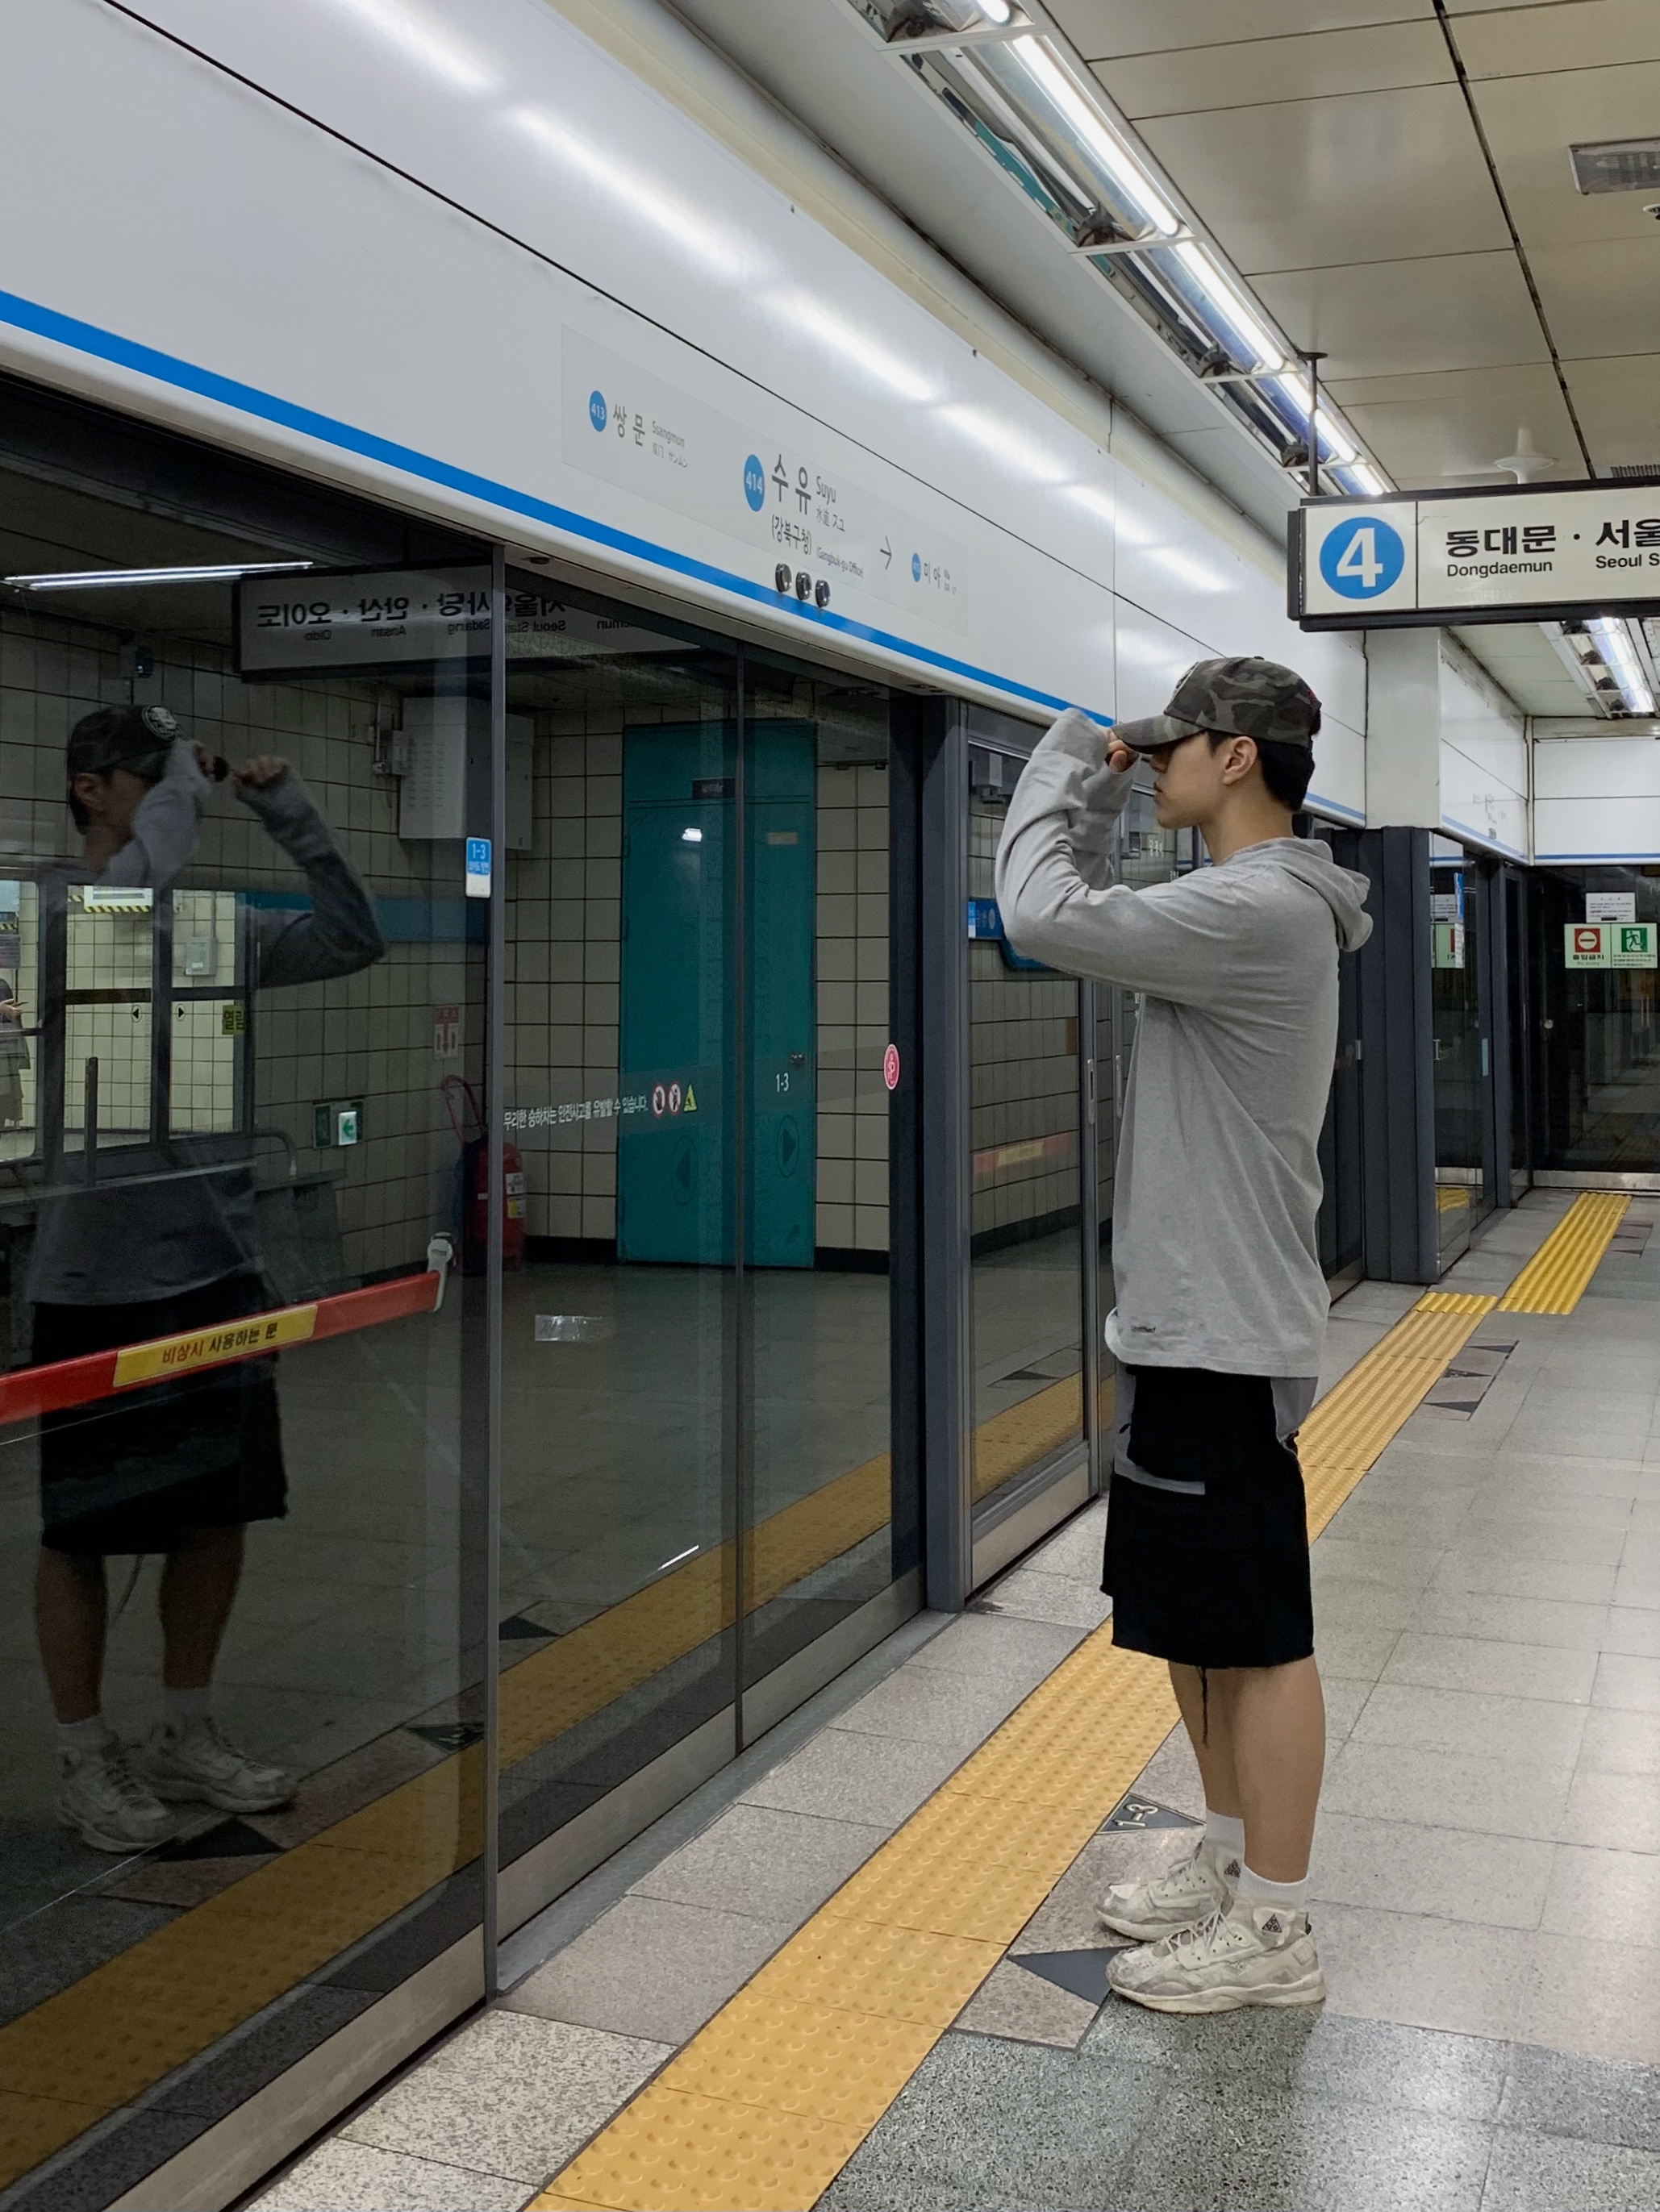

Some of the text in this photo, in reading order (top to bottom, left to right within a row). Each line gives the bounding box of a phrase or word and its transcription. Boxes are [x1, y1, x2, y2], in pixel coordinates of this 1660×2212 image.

[590, 403, 605, 420] 413
[613, 404, 645, 447] 쌍문
[652, 420, 685, 448] Ssangmun
[745, 472, 763, 494] 414
[772, 454, 811, 514] 수유
[816, 476, 836, 505] Suyu
[772, 514, 811, 555] (강북구청)
[1445, 525, 1556, 558] 동대문
[1337, 527, 1383, 588] 4
[1447, 560, 1553, 578] Dongdaemun
[1595, 554, 1642, 569] Seoul
[924, 561, 941, 589] 미아
[472, 844, 486, 860] 1-3
[776, 1073, 790, 1092] 1-3
[503, 1108, 527, 1131] 무리한
[162, 1323, 278, 1364] 비상시 사용하는 문
